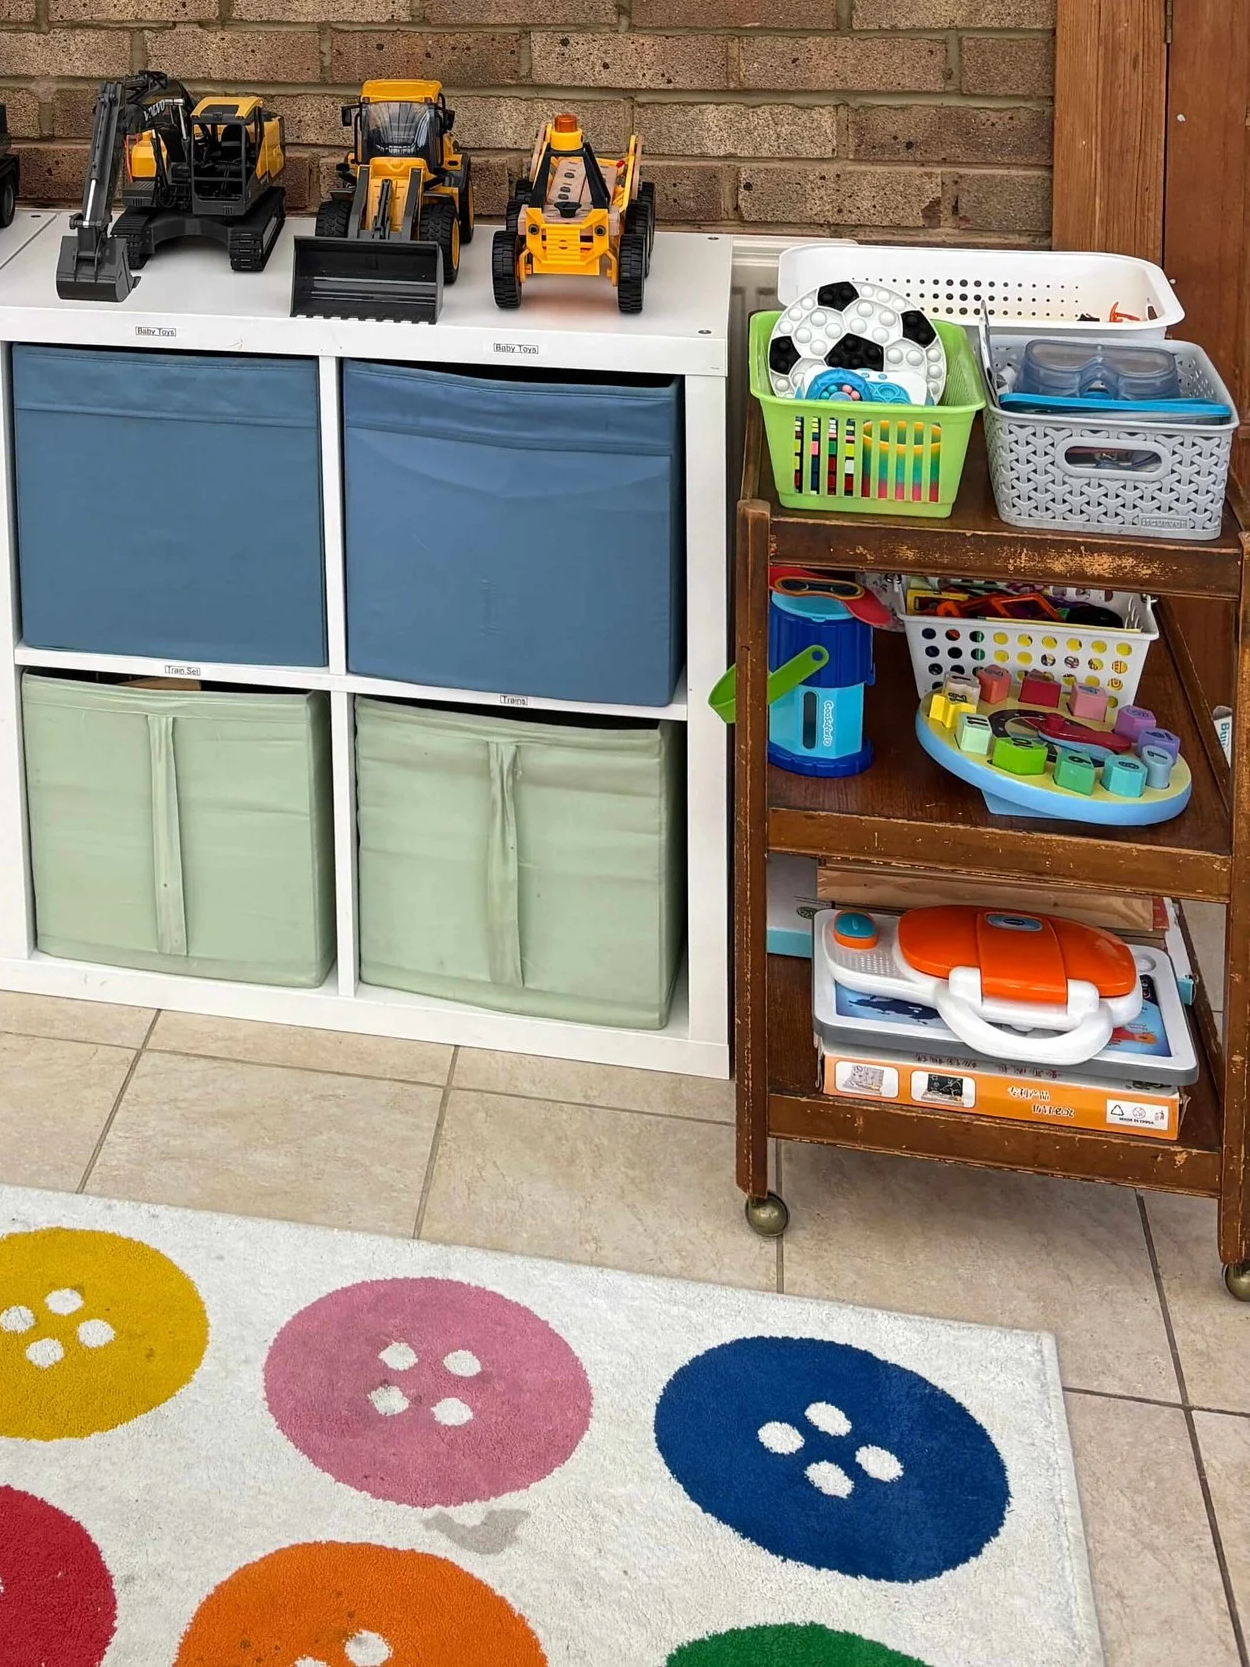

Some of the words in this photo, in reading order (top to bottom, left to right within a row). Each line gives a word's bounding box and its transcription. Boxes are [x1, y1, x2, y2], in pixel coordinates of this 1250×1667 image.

[137, 326, 156, 336] Baby
[157, 328, 175, 337] Toys
[495, 343, 516, 353] Baby
[517, 344, 537, 354] Toys
[166, 665, 185, 675] Train
[186, 666, 199, 676] Set
[501, 695, 526, 706] Trains
